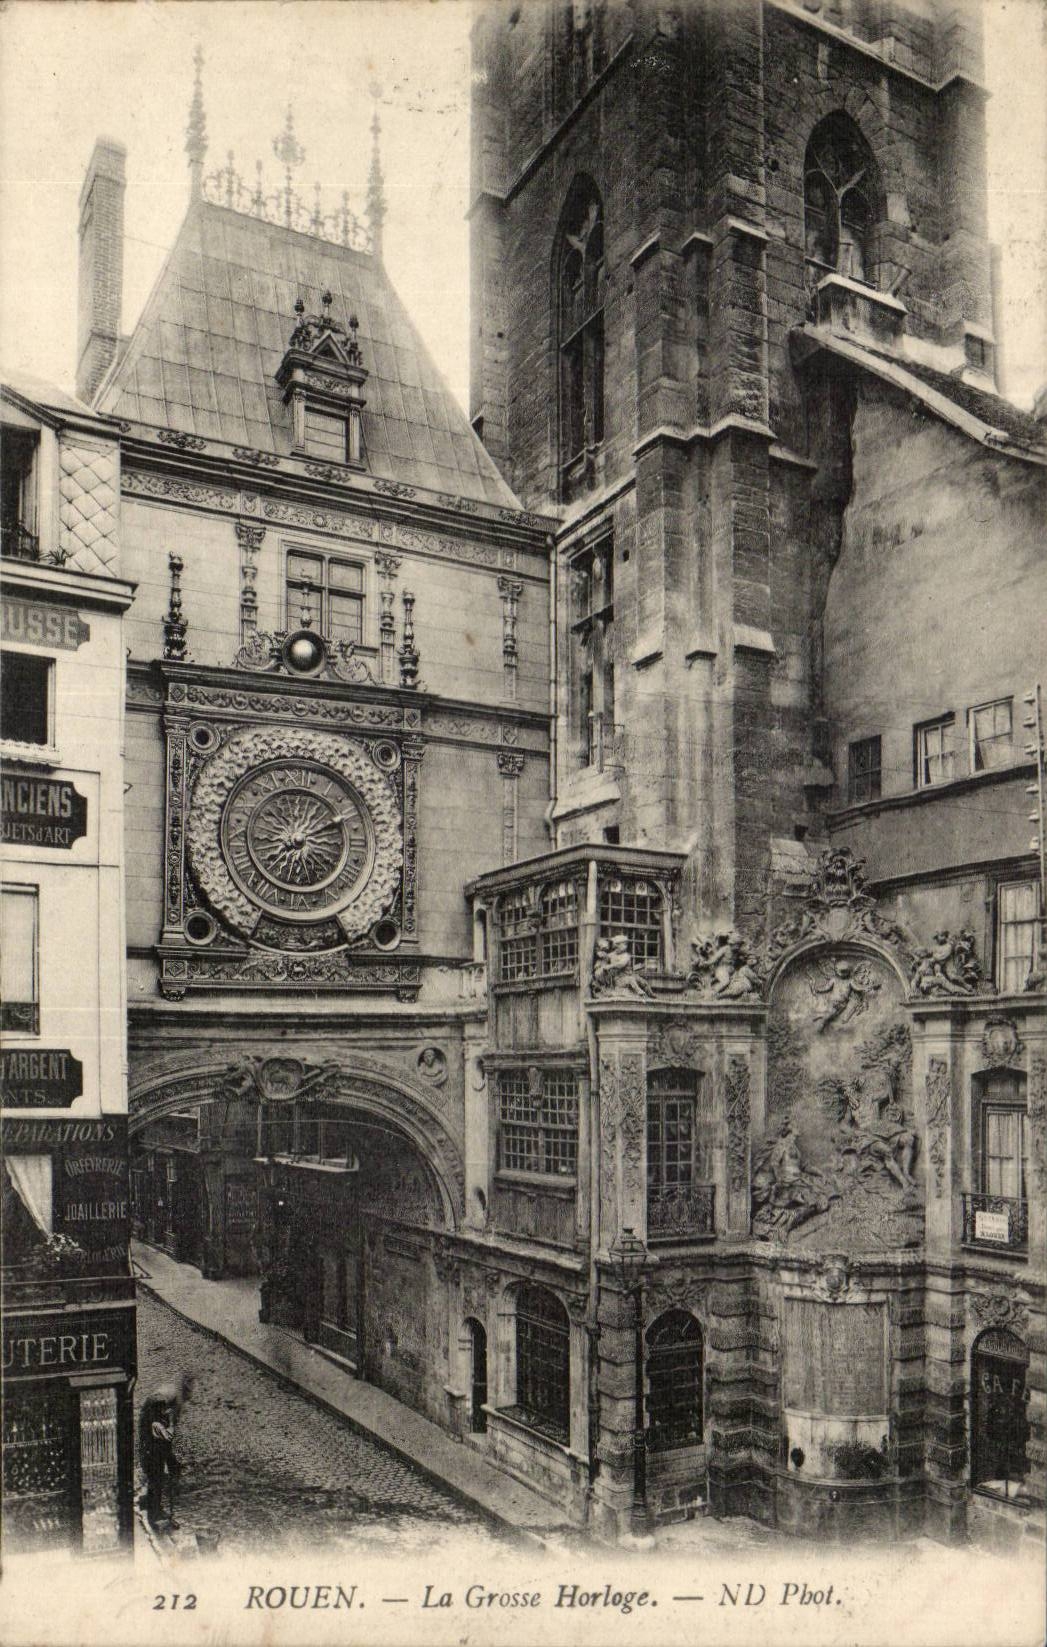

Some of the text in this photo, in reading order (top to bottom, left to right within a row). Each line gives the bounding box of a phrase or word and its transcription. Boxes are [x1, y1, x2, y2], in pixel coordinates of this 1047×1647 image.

[0, 605, 79, 645] USSE
[0, 780, 73, 818] NCIENS
[0, 1088, 47, 1105] NTS
[64, 1200, 127, 1221] JOAILLERIE
